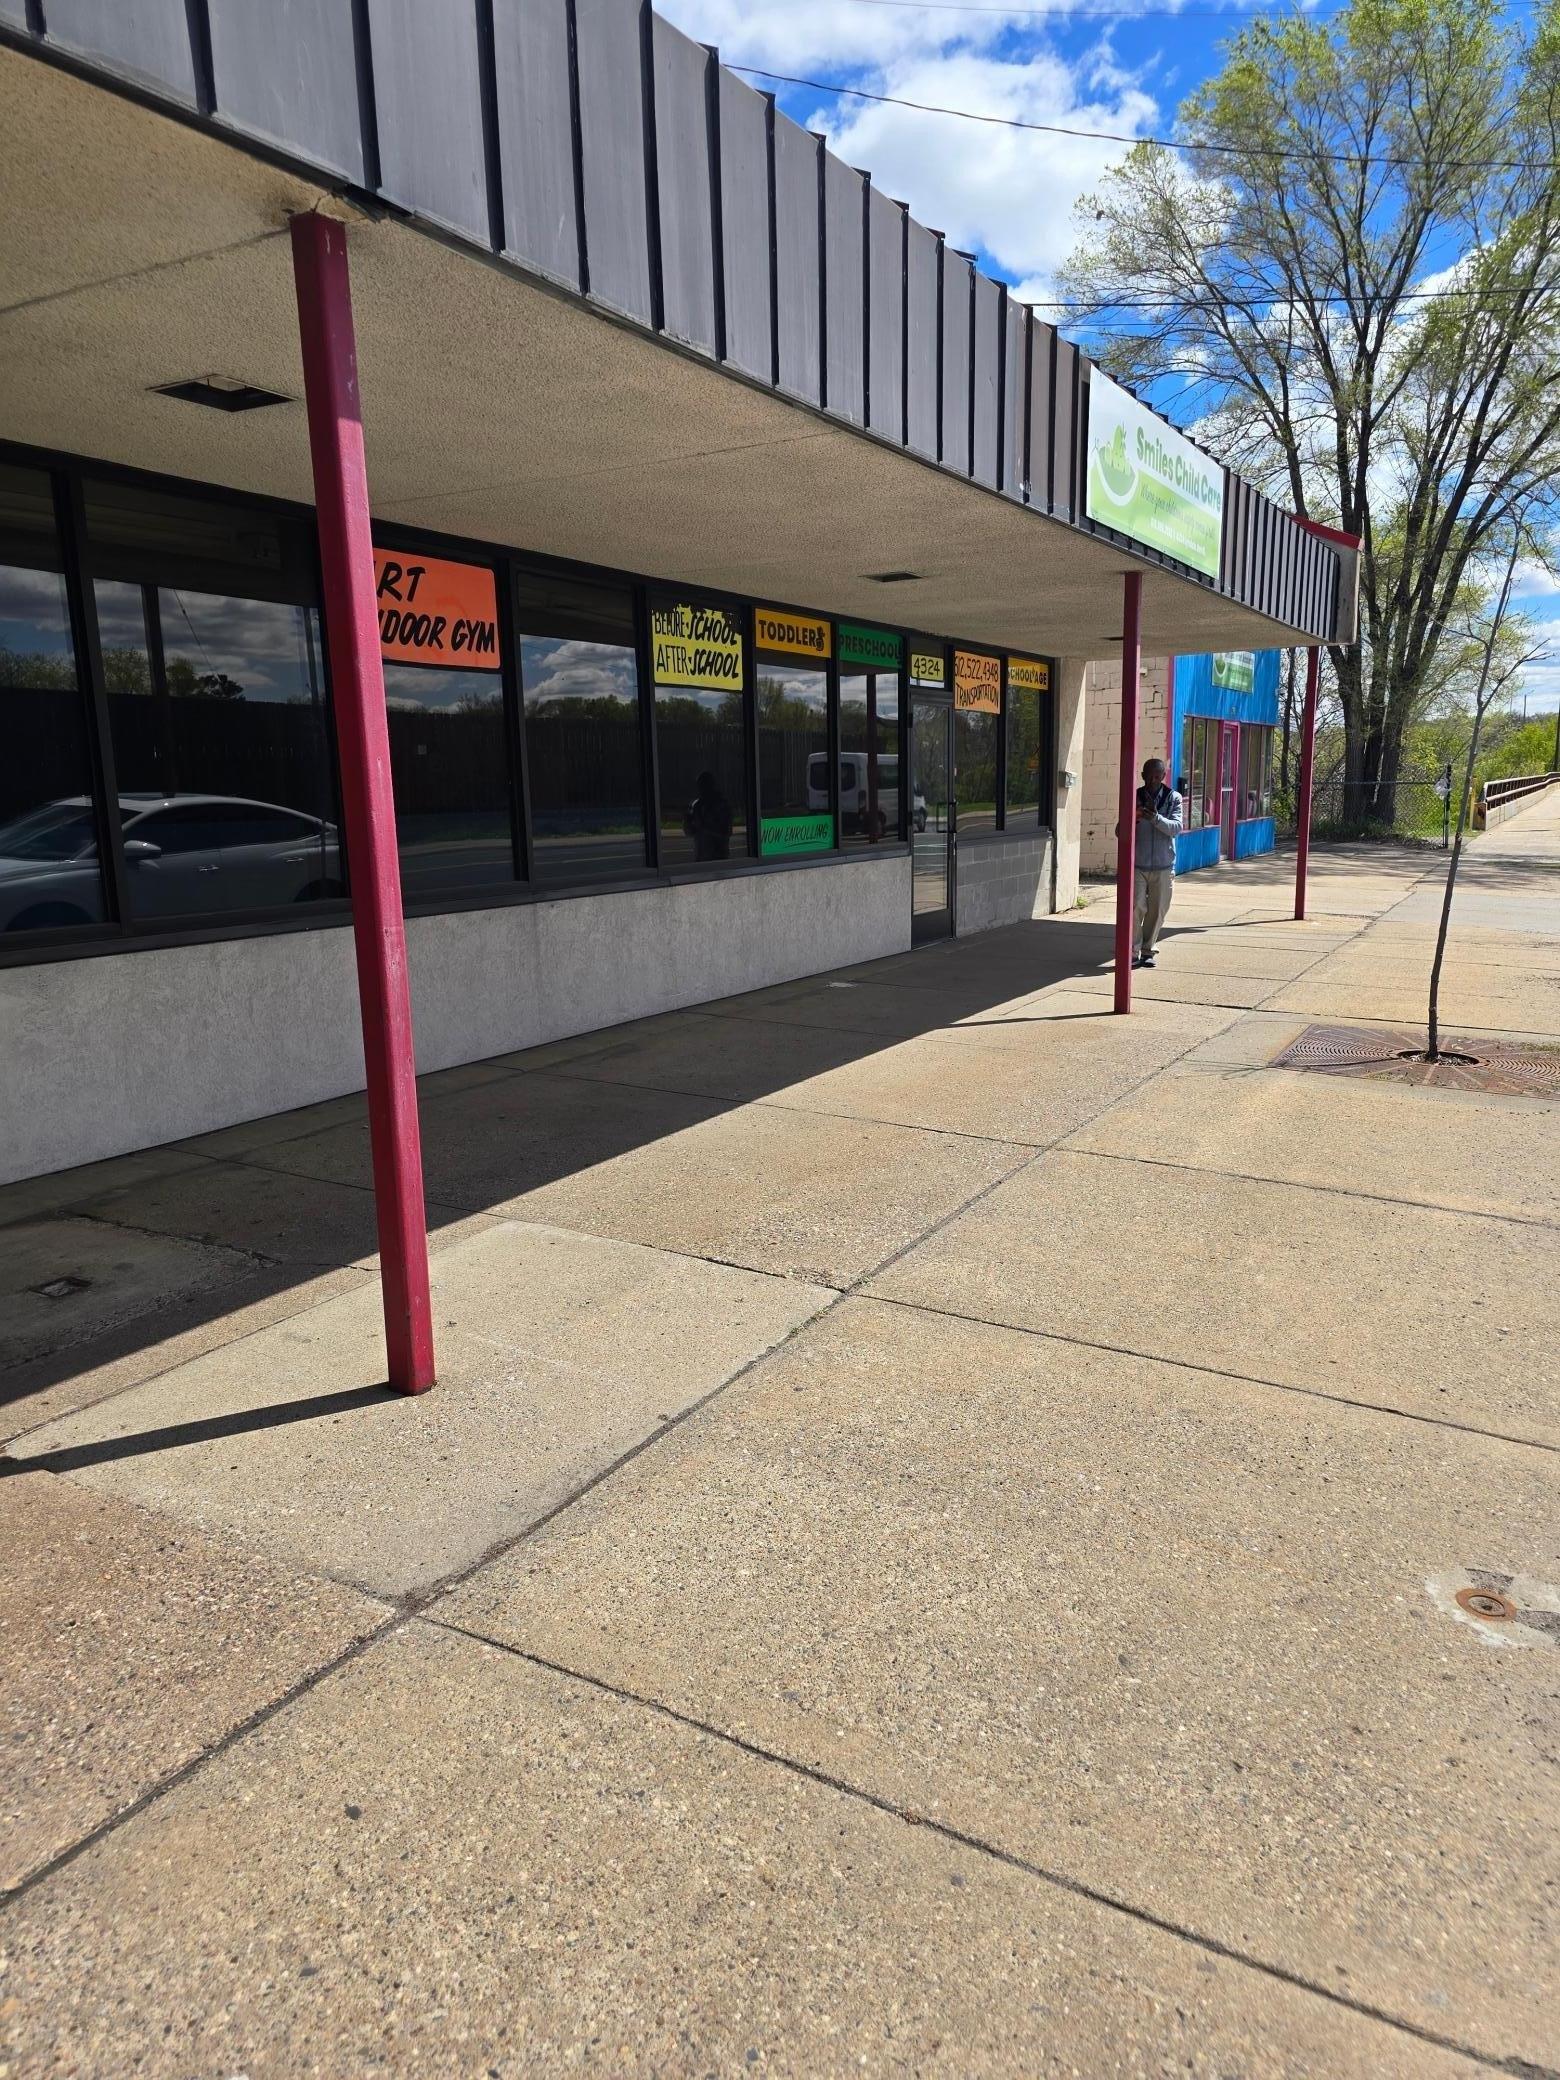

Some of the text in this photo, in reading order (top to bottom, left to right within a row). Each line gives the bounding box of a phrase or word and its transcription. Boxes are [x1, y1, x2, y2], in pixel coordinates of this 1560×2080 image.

[1136, 426, 1174, 482] Smiles
[1175, 454, 1200, 500] Child
[1201, 474, 1221, 512] Care
[373, 560, 426, 602] RT
[450, 618, 495, 653] GYM
[913, 658, 941, 676] 4324
[956, 682, 999, 709] TRANSPORTATION
[761, 823, 828, 844] NOW ENROLLING
